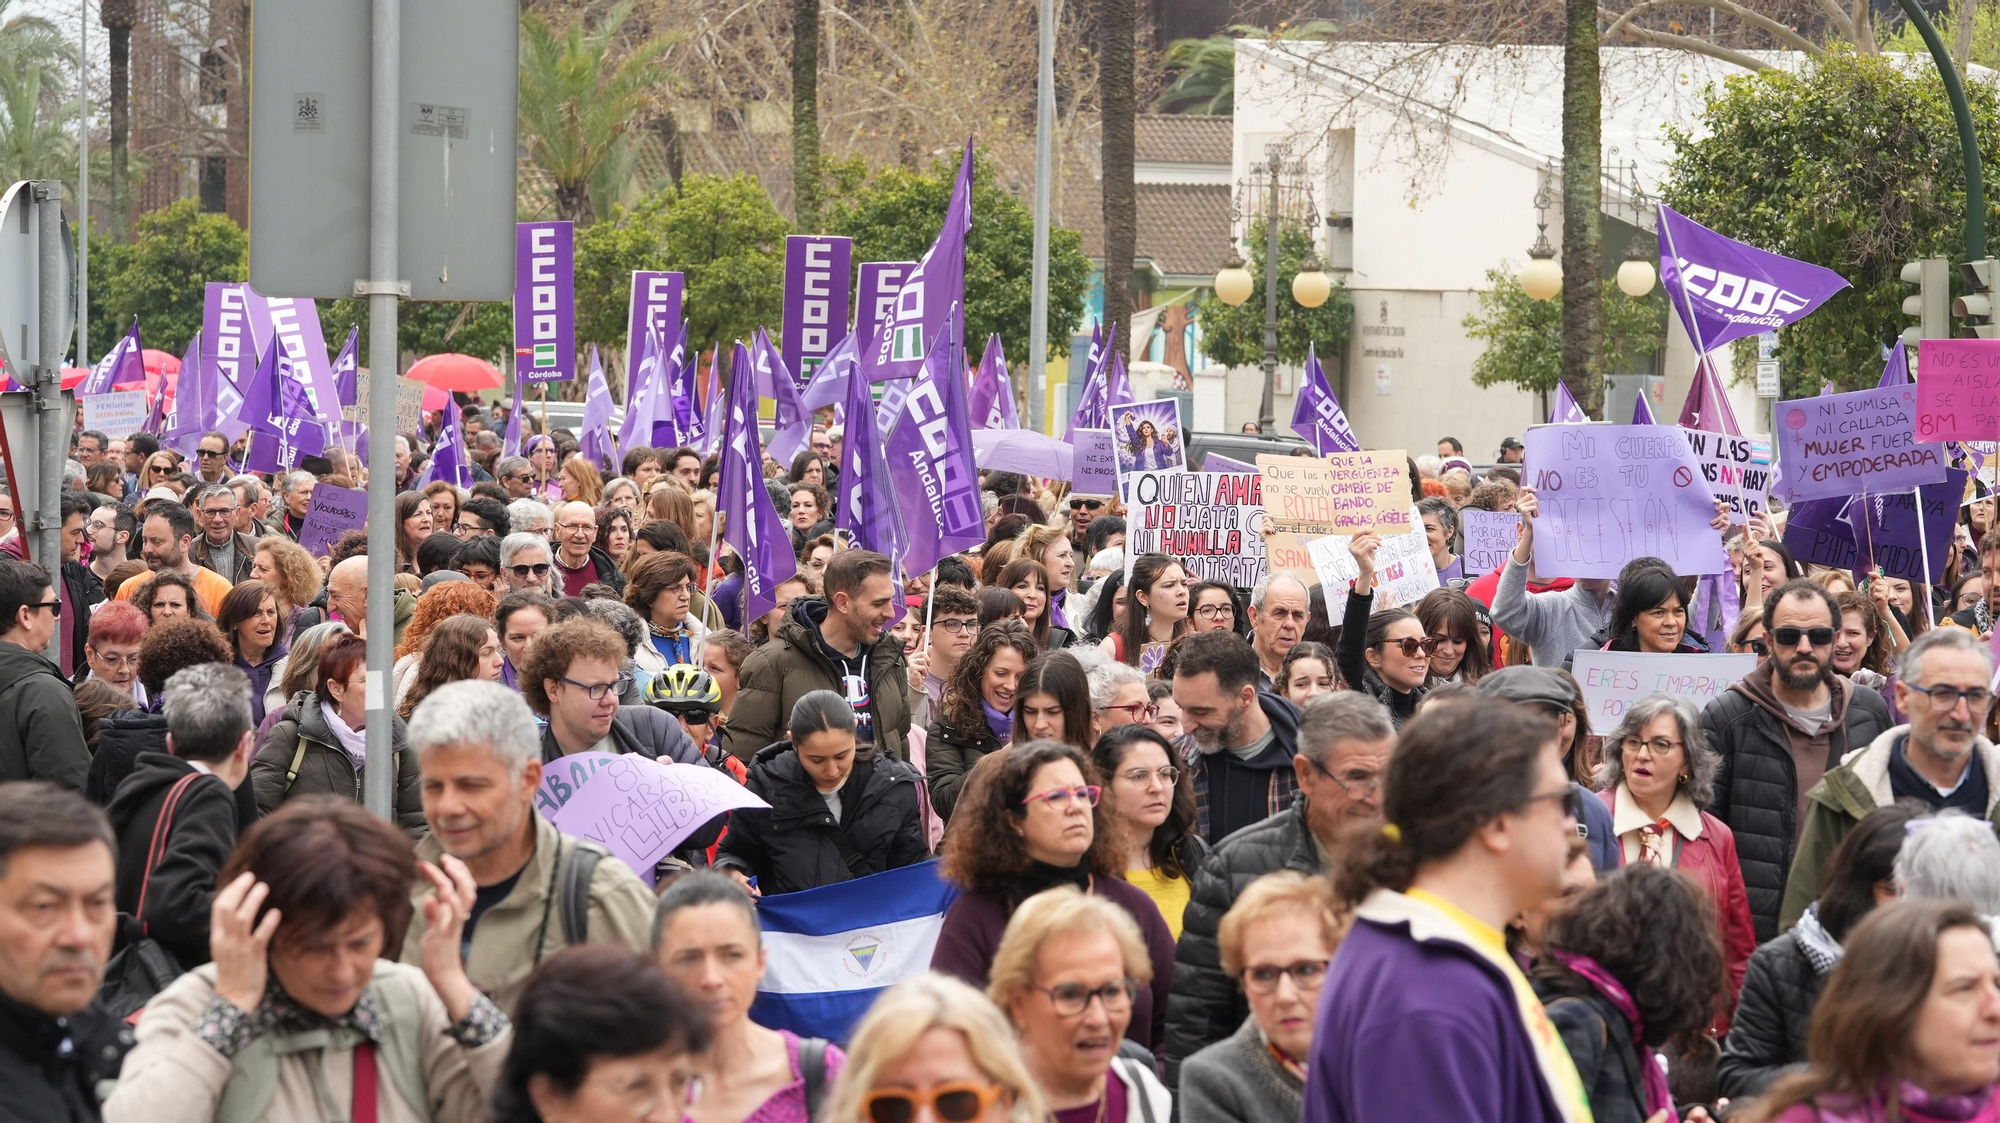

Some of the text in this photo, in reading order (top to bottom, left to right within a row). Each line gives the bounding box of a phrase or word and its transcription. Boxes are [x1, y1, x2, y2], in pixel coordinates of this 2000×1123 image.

[531, 228, 557, 340] CCOO
[802, 243, 832, 352] CCOO
[1933, 352, 1955, 368] NO
[1960, 353, 1981, 368] ES
[528, 370, 562, 379] Córdoba
[1820, 396, 1900, 417] NI SUMISA
[1935, 392, 1954, 408] SE
[1816, 412, 1909, 436] NI CALLADA
[1920, 413, 1956, 436] 8M
[1095, 442, 1105, 450] NI
[1562, 431, 1685, 460] MI CUERPO
[1715, 438, 1750, 463] LAS
[1804, 431, 1915, 459] MUJER FUER
[1267, 466, 1295, 480] Que
[1303, 470, 1318, 480] las
[1331, 456, 1373, 467] QUE LA
[1812, 450, 1938, 482] EMPODERADA
[1331, 467, 1400, 481] VERGÜENZA
[1536, 465, 1649, 492] NO ES TU
[1720, 465, 1743, 485] NO
[1743, 469, 1768, 491] HAY
[1265, 484, 1330, 496] no se vuelv
[1377, 481, 1394, 494] DE
[1283, 494, 1330, 522] ROJA
[1333, 498, 1378, 511] BANDO.
[1145, 505, 1239, 530] NO MATA
[1470, 511, 1488, 523] YO
[1291, 523, 1301, 534] el
[1306, 523, 1327, 535] color
[1470, 525, 1505, 539] PORQUE
[1549, 493, 1680, 565] DECISIÓN
[1477, 538, 1493, 549] ME
[1321, 558, 1352, 587] ME
[1399, 532, 1423, 557] LAS
[1349, 556, 1419, 589] MJERES Y
[1586, 668, 1640, 691] ERES
